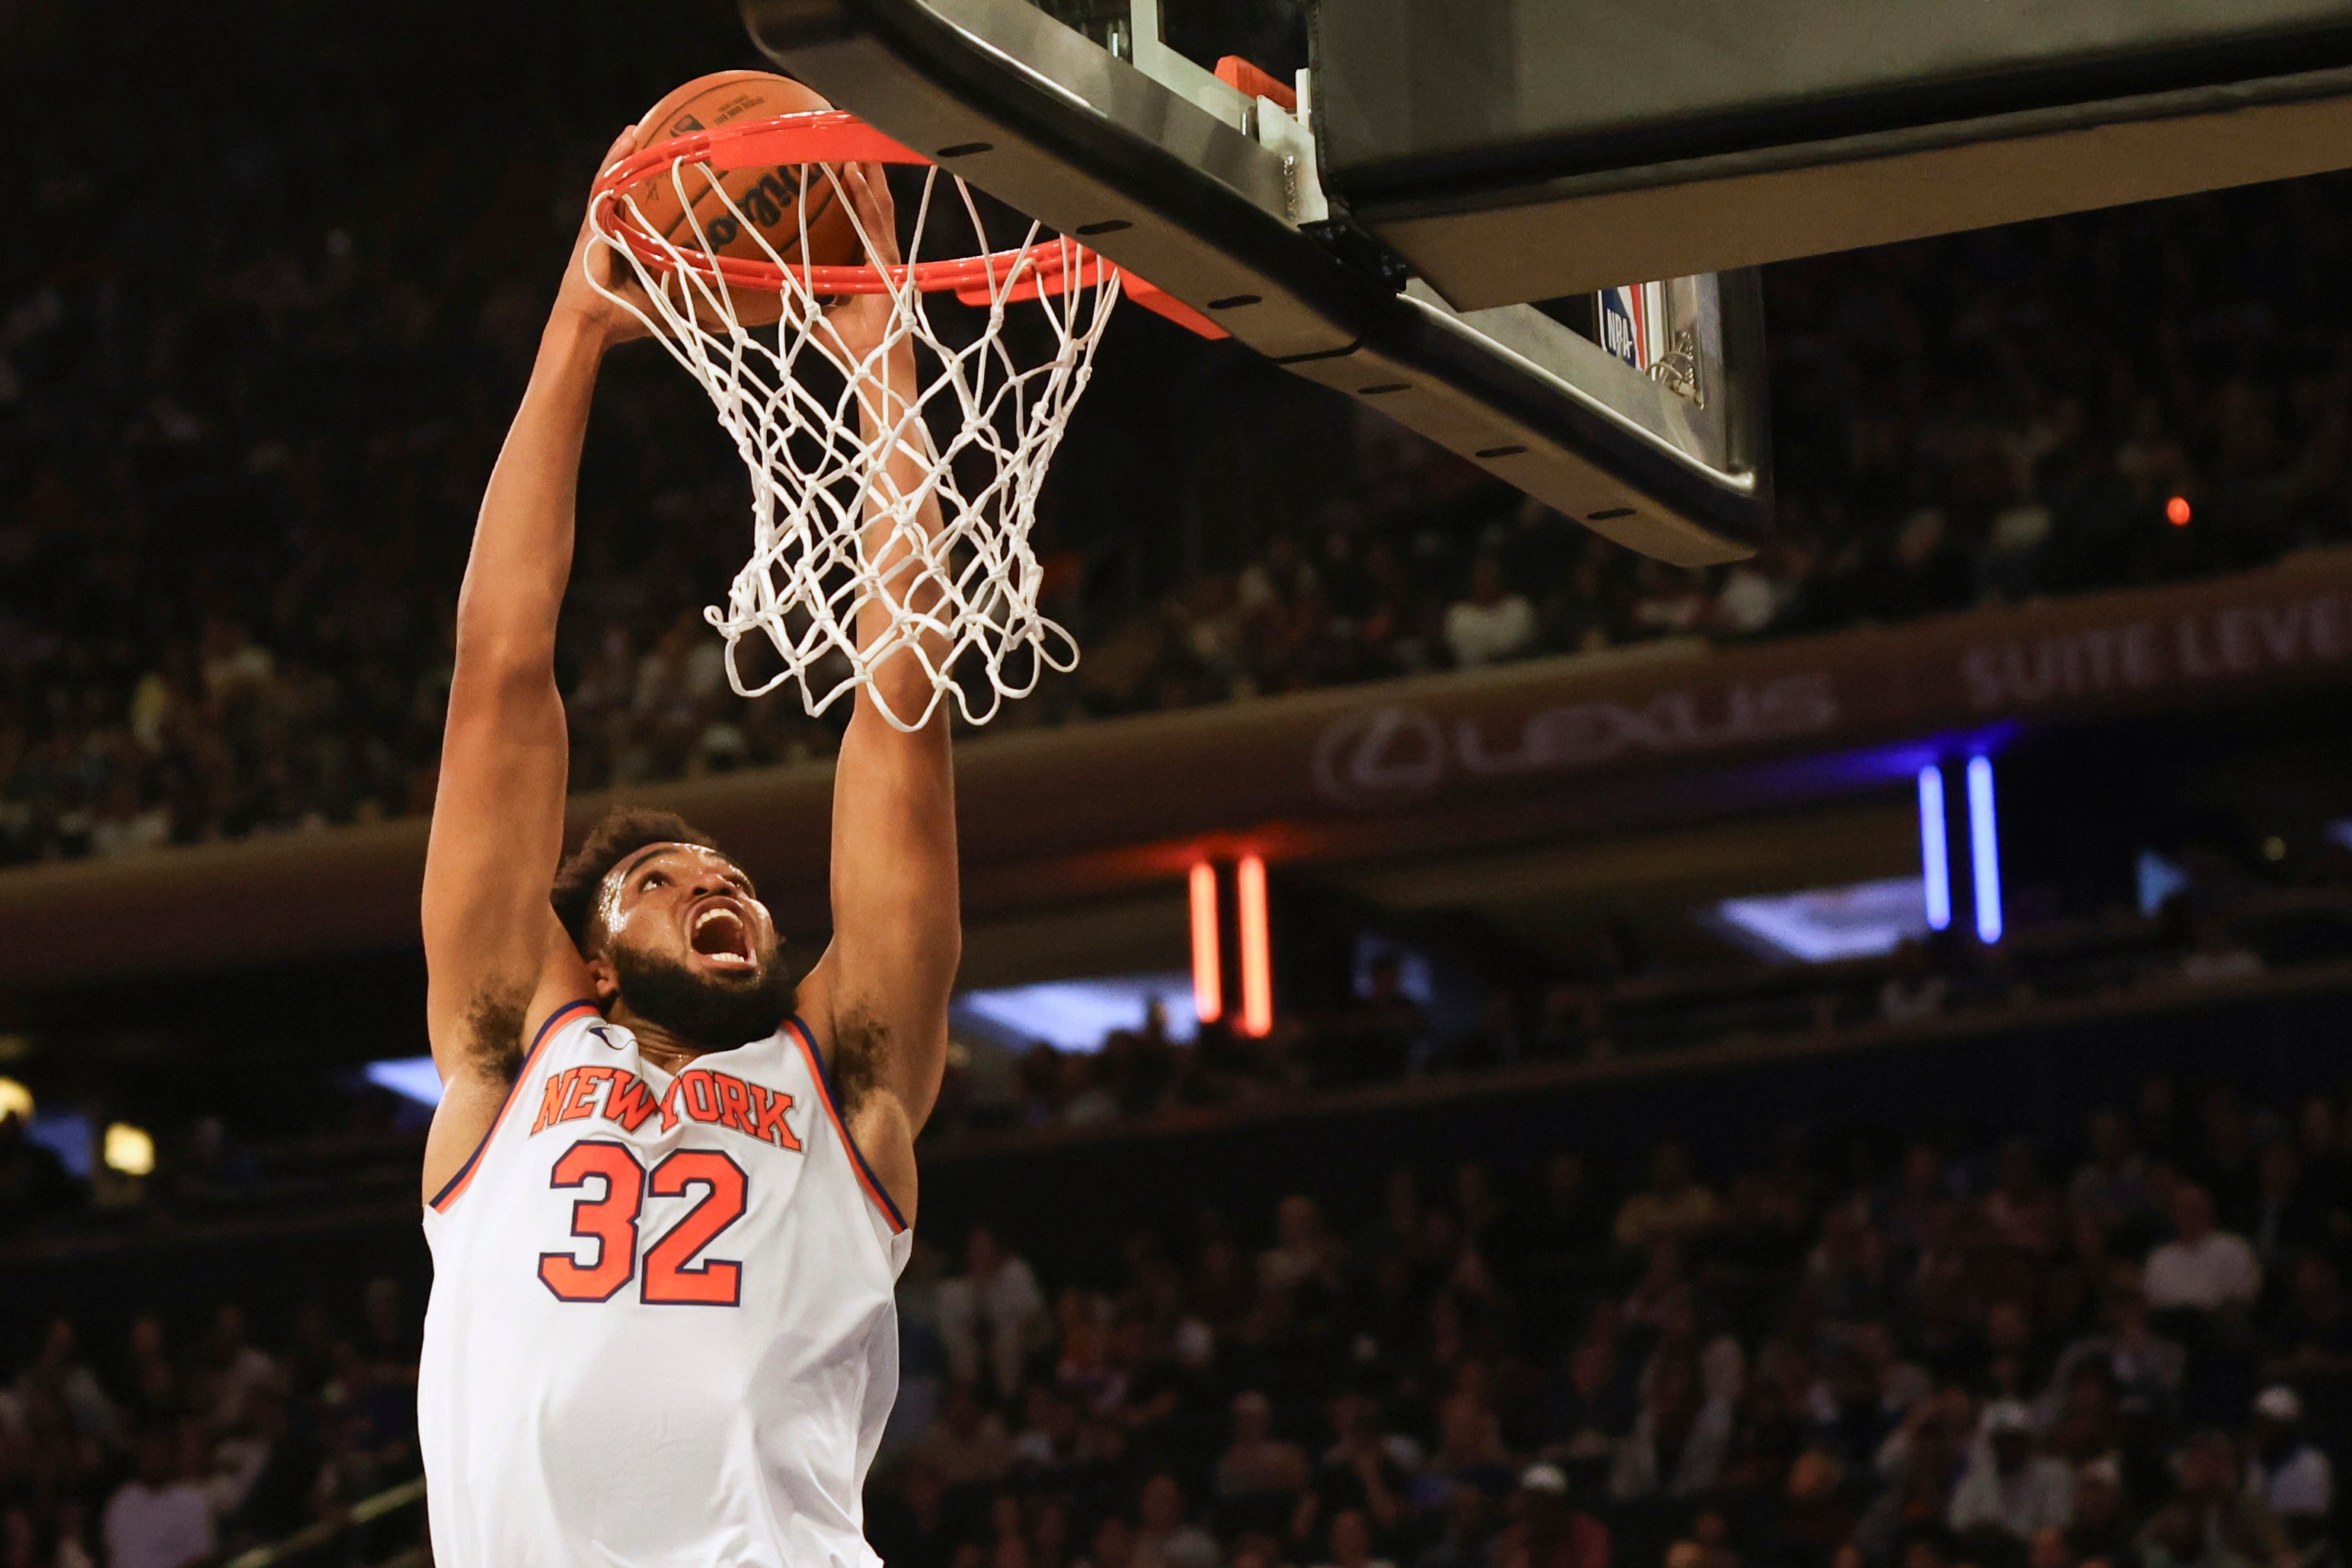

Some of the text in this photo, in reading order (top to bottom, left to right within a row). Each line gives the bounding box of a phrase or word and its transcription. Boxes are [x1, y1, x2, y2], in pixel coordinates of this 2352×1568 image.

[1607, 308, 1632, 359] NBA
[2178, 595, 2351, 678] LEVE
[531, 1065, 803, 1153] NEW YORK
[538, 1140, 749, 1308] 32
